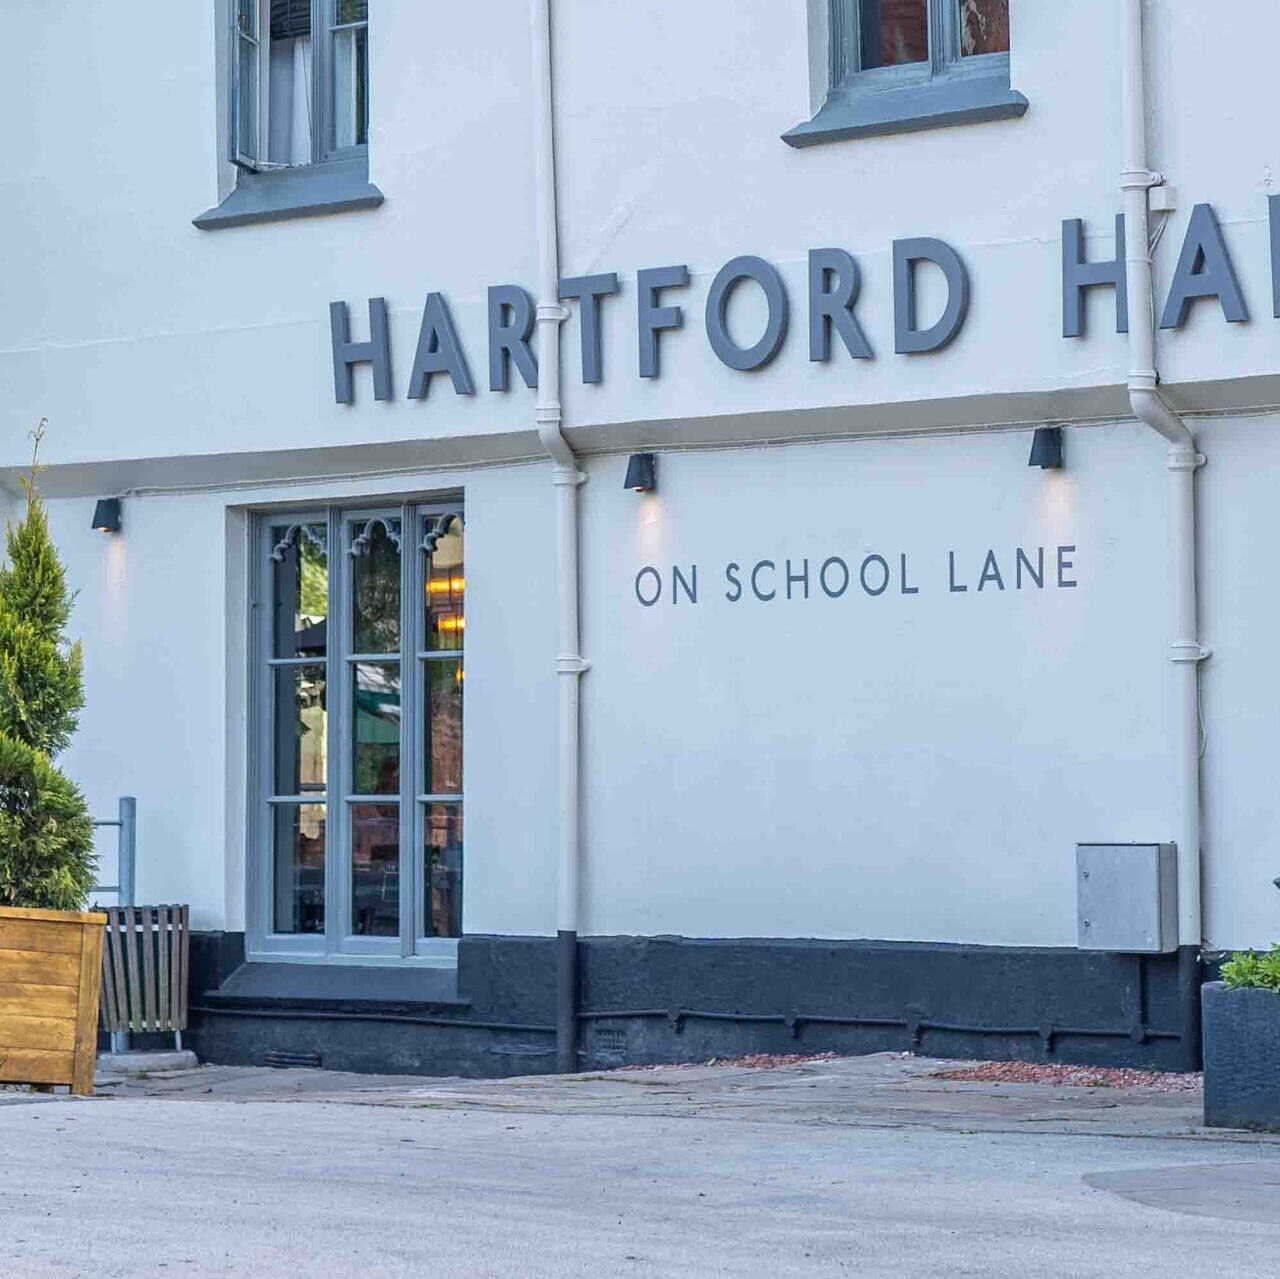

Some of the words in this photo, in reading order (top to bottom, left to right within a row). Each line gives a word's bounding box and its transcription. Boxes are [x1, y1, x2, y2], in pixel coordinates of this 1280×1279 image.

[329, 236, 971, 405] HARTFORD
[635, 564, 698, 607] ON
[725, 553, 920, 603] SCHOOL
[948, 545, 1078, 593] LANE
